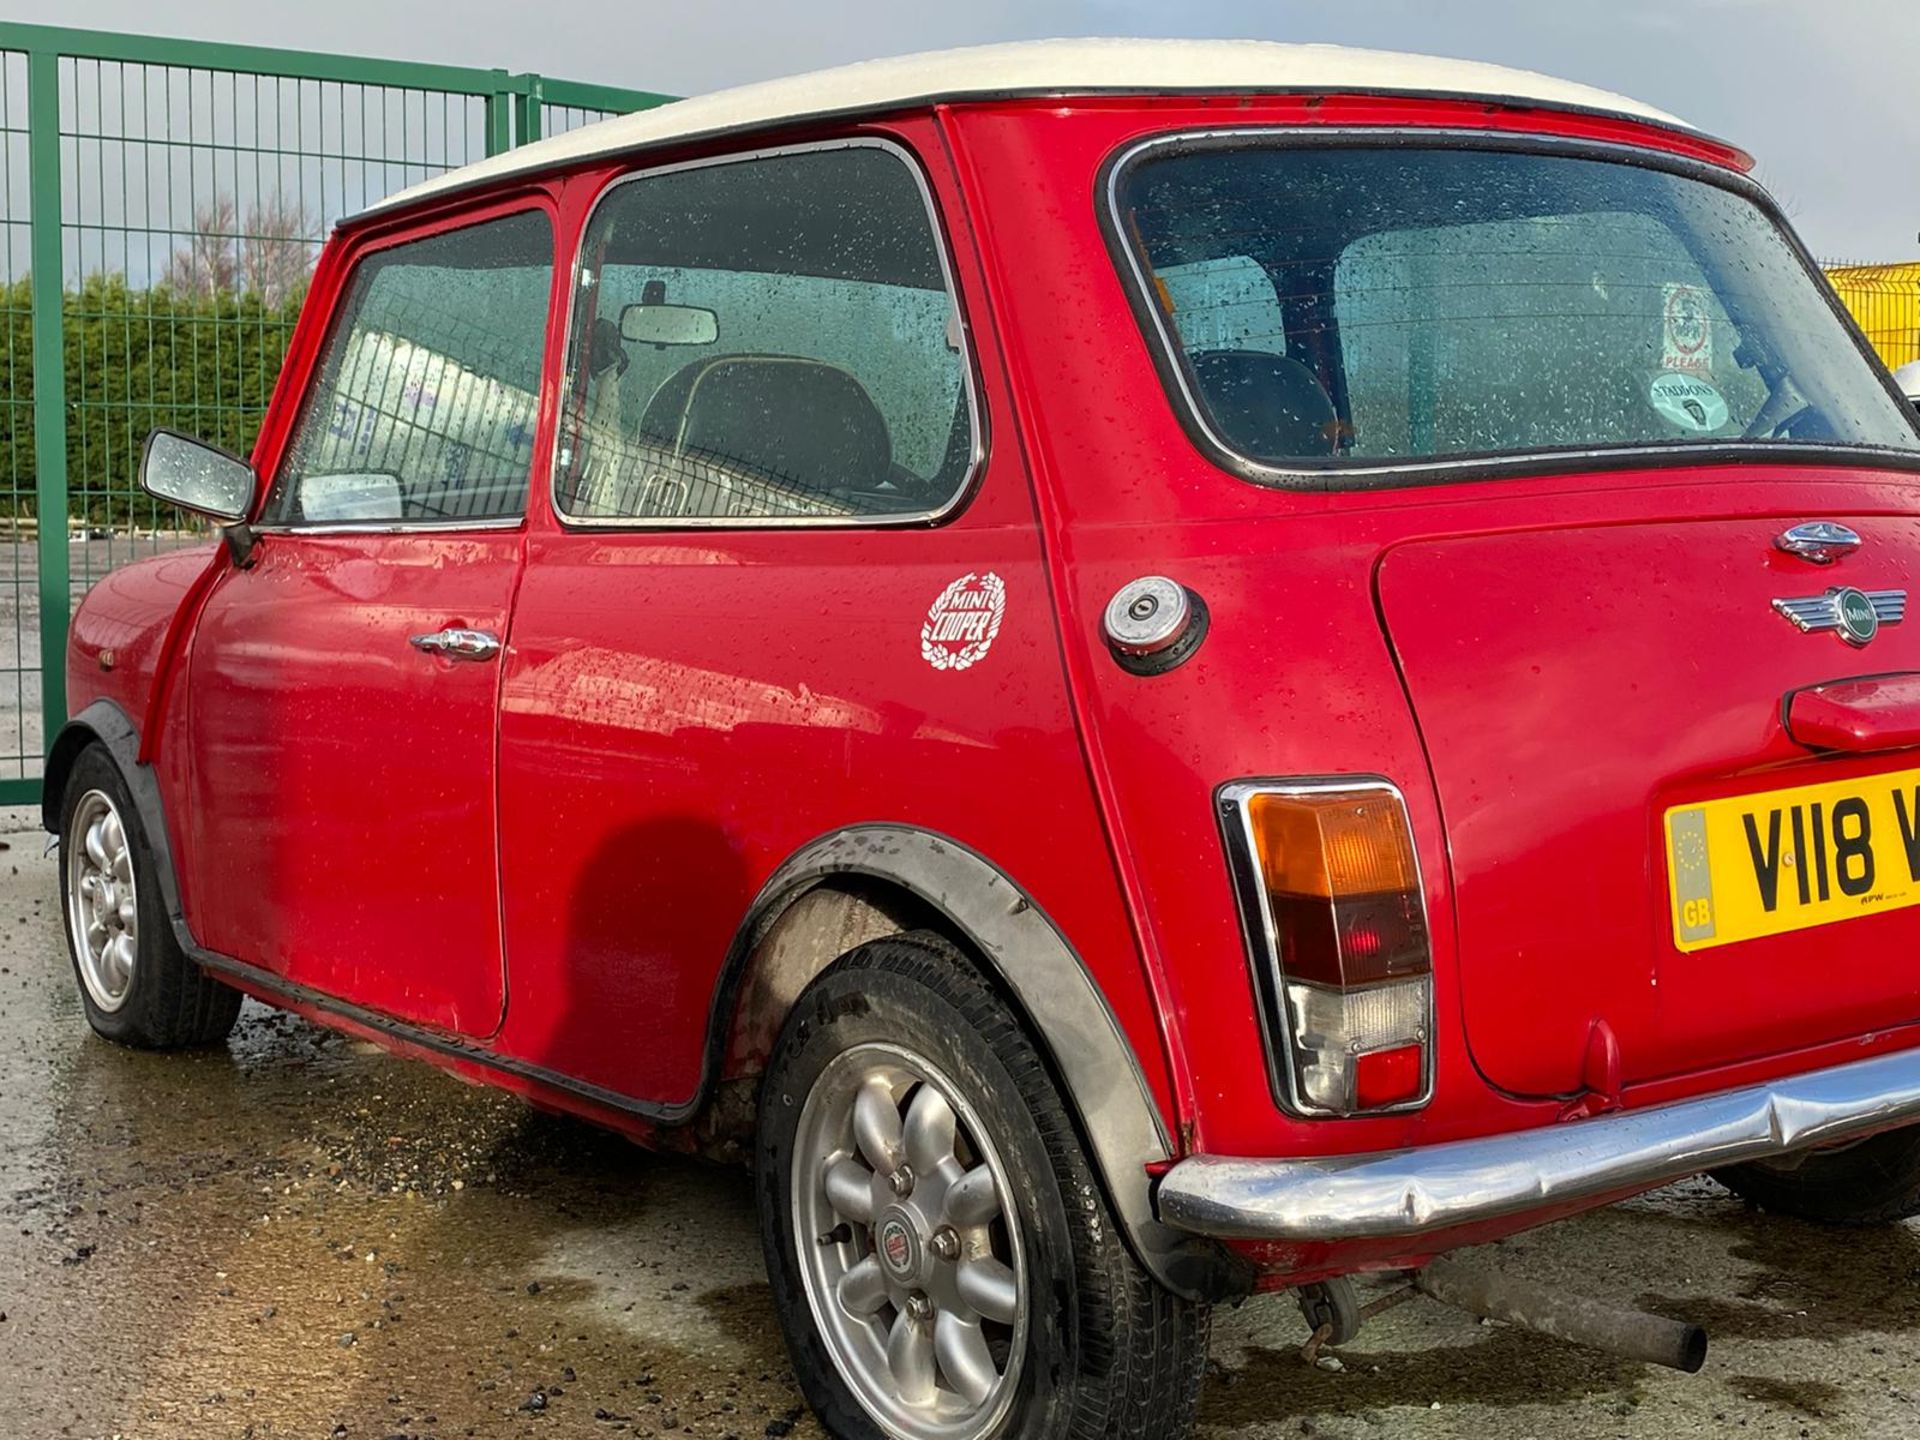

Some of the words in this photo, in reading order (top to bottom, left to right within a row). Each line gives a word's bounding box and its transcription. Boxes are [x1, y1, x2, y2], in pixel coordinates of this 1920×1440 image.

[949, 591, 990, 609] MINI
[930, 611, 992, 641] COOPER
[1846, 608, 1873, 621] MINI
[1742, 797, 1875, 912] V118
[1683, 900, 1711, 928] GB
